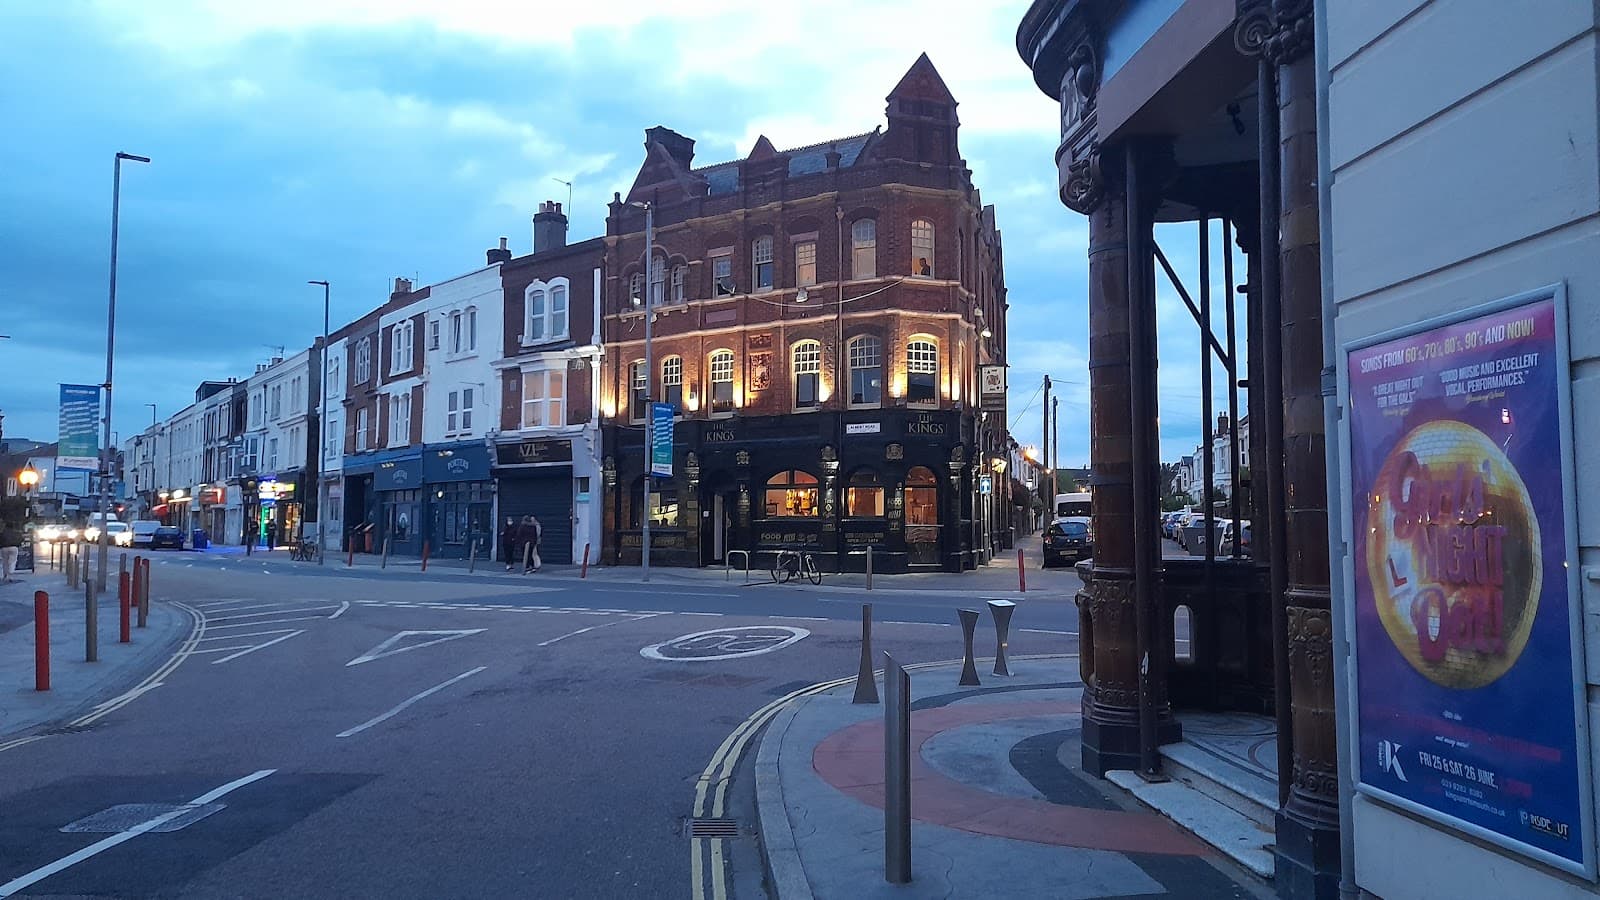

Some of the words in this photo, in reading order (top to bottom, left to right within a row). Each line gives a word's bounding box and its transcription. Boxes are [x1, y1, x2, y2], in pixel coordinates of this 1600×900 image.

[1361, 354, 1382, 373] SONGS
[1382, 350, 1404, 369] FROM
[1485, 325, 1505, 344] AND
[1506, 317, 1535, 339] NOW!
[1458, 365, 1480, 380] MUSIC
[1479, 361, 1495, 377] AND
[1495, 353, 1539, 373] EXCELLENT
[1445, 381, 1467, 397] VOCAL
[706, 431, 735, 442] KINGS
[908, 423, 944, 434] KINGS
[1419, 751, 1432, 767] FRI
[1433, 755, 1442, 770] 25
[1443, 758, 1449, 773] &
[1449, 760, 1463, 777] SAT
[1464, 765, 1476, 781] 26
[1530, 814, 1552, 831] INSIDE
